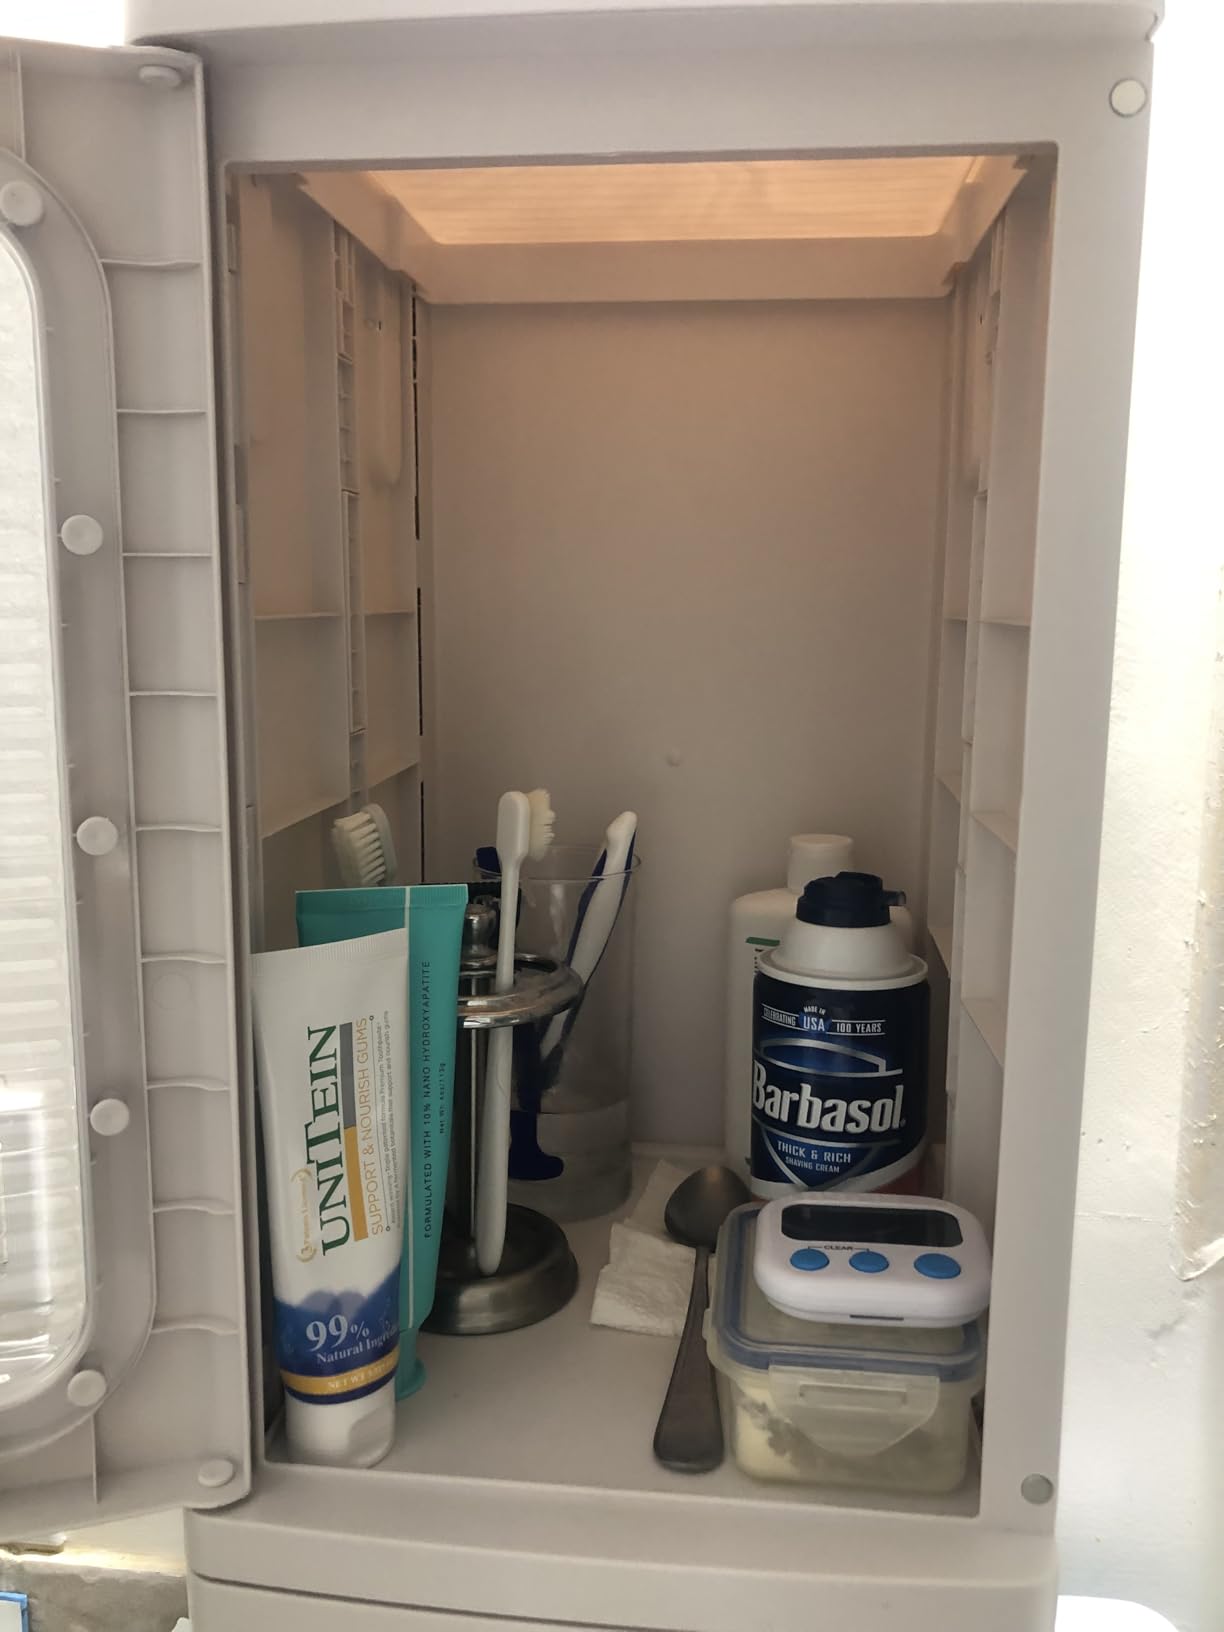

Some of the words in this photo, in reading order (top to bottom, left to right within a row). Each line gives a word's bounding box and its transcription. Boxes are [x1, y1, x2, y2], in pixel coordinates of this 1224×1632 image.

[421, 961, 430, 1062] HYDROXYAPATITE
[763, 1007, 796, 1026] CELEBRATING
[836, 1023, 852, 1033] 100
[856, 1023, 882, 1033] YEARS
[803, 1005, 818, 1013] MADE
[803, 1015, 825, 1032] USA
[355, 1018, 369, 1064] GUMS
[422, 1066, 430, 1098] NANO
[752, 1059, 904, 1134] Barbasol
[358, 1068, 372, 1140] NOURISH
[423, 1103, 431, 1125] 10%
[361, 1143, 375, 1155] &
[423, 1130, 431, 1159] WITH
[777, 1141, 806, 1158] THICK
[811, 1150, 818, 1160] &
[824, 1151, 851, 1163] RICH
[785, 1156, 813, 1170] SHAVING
[815, 1162, 840, 1173] CREAM
[363, 1161, 383, 1236] SUPPORT
[423, 1163, 432, 1239] FORMULATED
[306, 1314, 370, 1352] 99%
[317, 1342, 363, 1364] Natural
